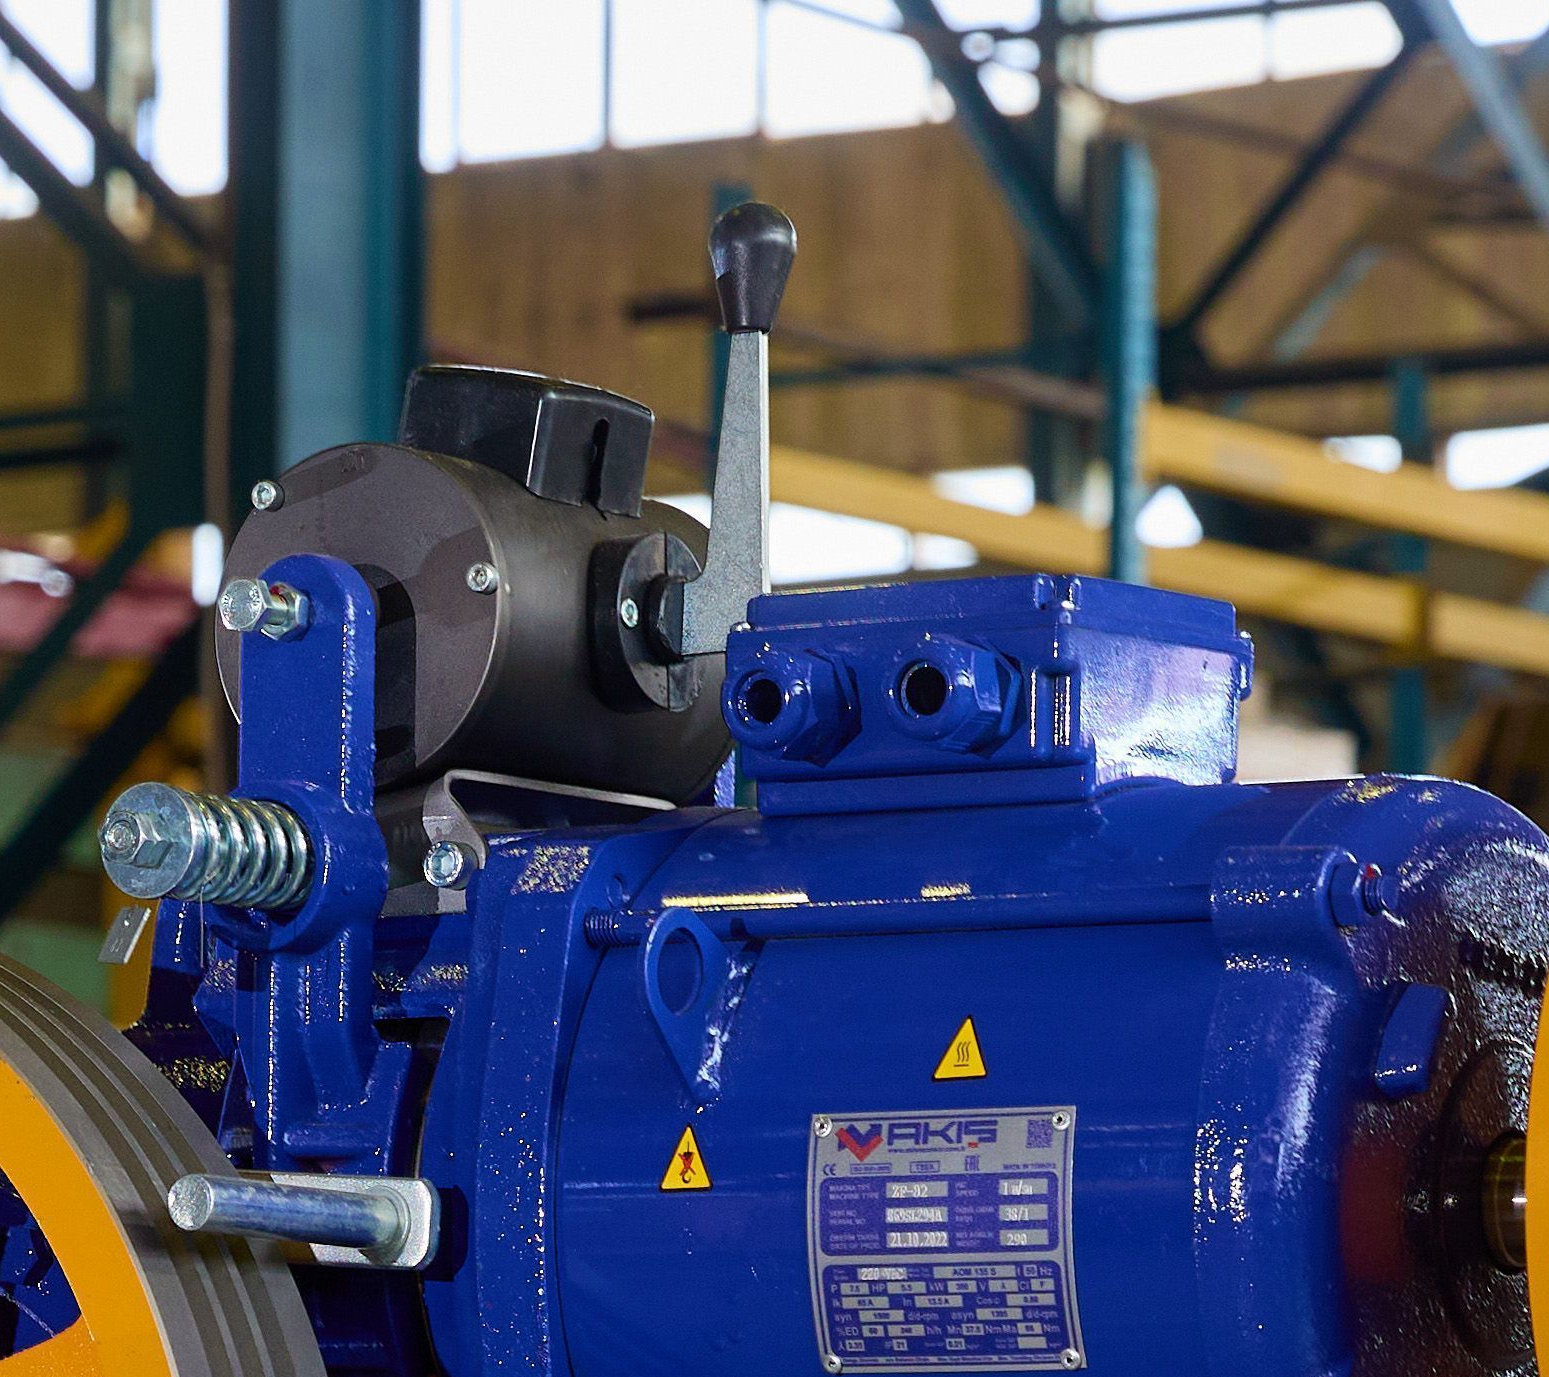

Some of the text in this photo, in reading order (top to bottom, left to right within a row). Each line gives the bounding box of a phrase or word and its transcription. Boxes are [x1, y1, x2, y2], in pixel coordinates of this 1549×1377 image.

[1039, 1266, 1053, 1276] Hz
[831, 1284, 838, 1294] P
[872, 1283, 886, 1293] HP
[979, 1282, 987, 1292] V
